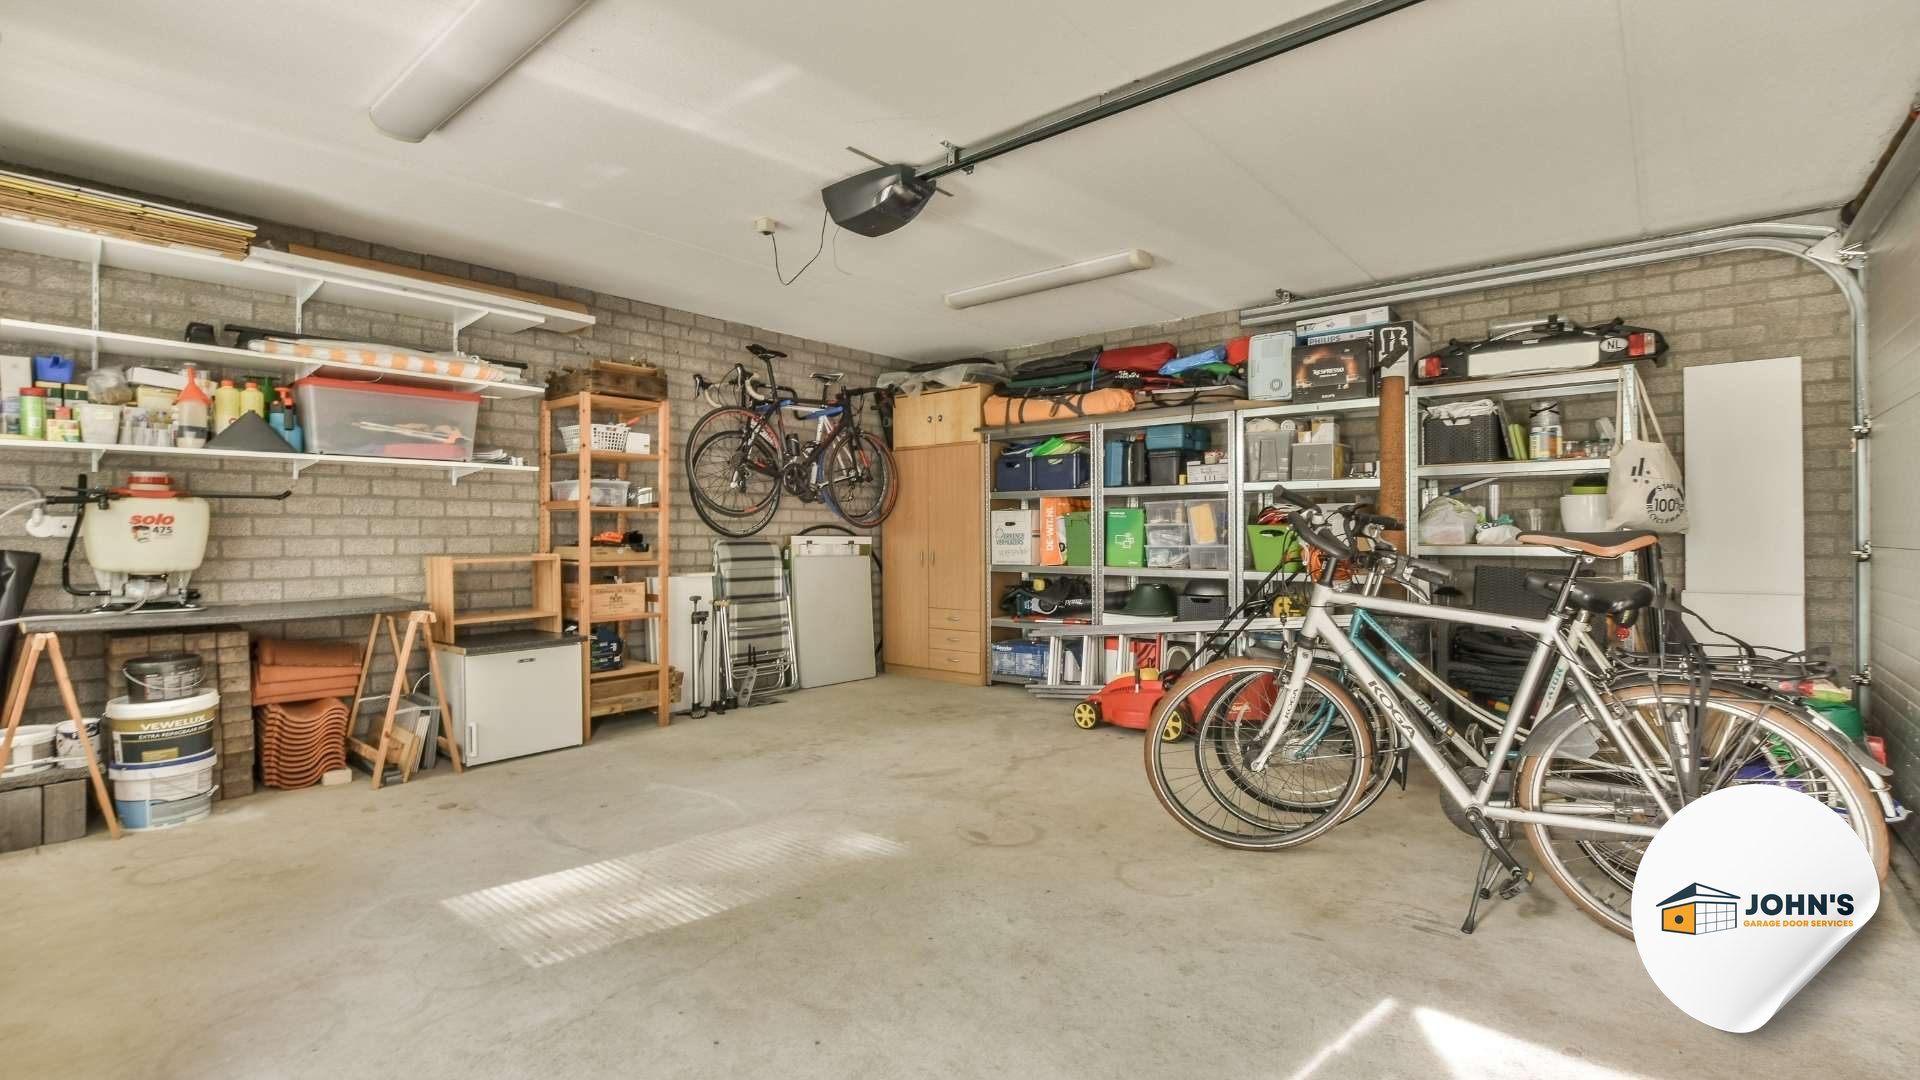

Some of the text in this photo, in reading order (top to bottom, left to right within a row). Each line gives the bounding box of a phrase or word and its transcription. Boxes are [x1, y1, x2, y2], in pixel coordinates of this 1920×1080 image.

[1308, 334, 1341, 345] PHILIPS
[1607, 340, 1622, 350] NL
[128, 513, 175, 525] solo
[152, 526, 174, 534] 475
[1367, 680, 1417, 740] KOGA
[140, 714, 207, 731] VEWELUX
